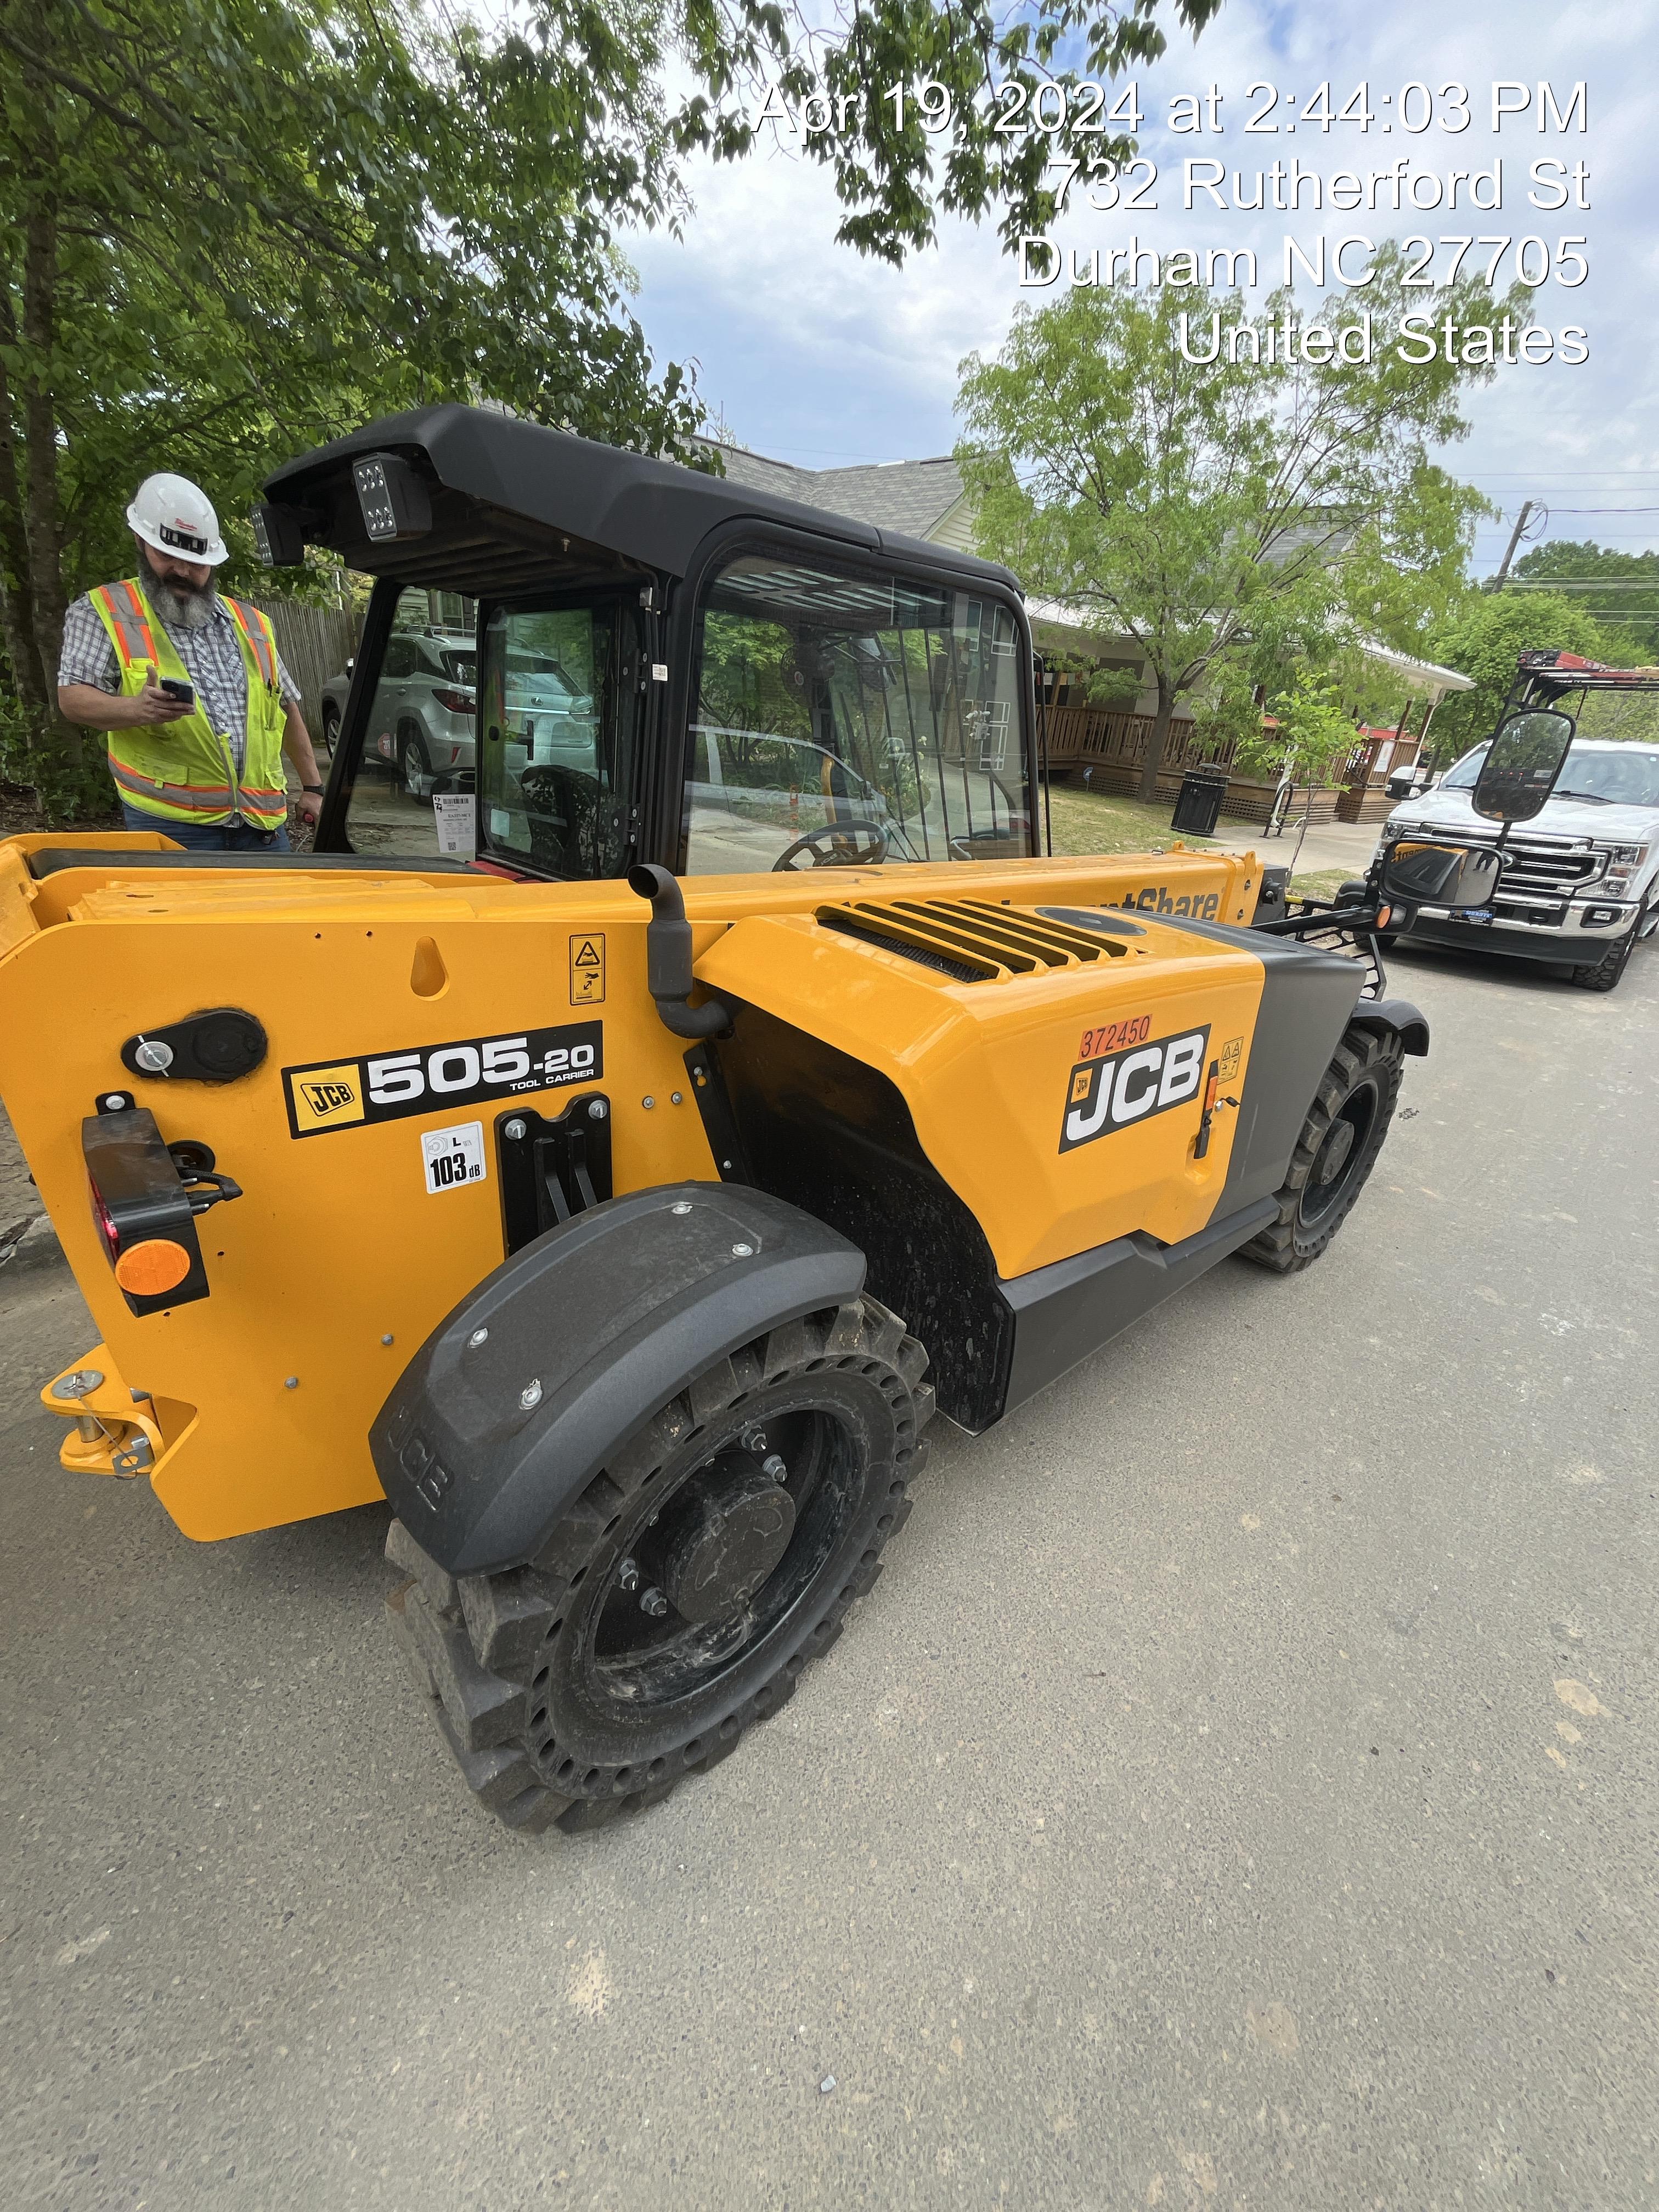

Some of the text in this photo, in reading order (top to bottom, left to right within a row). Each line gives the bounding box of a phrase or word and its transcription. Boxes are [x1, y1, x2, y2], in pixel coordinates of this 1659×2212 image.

[1081, 1015, 1150, 1058] 372450
[311, 1037, 594, 1112] JCB 505-20
[510, 1069, 594, 1091] TOOL CARRIER
[1066, 1034, 1204, 1141] JCB
[430, 1153, 481, 1188] 103 dB
